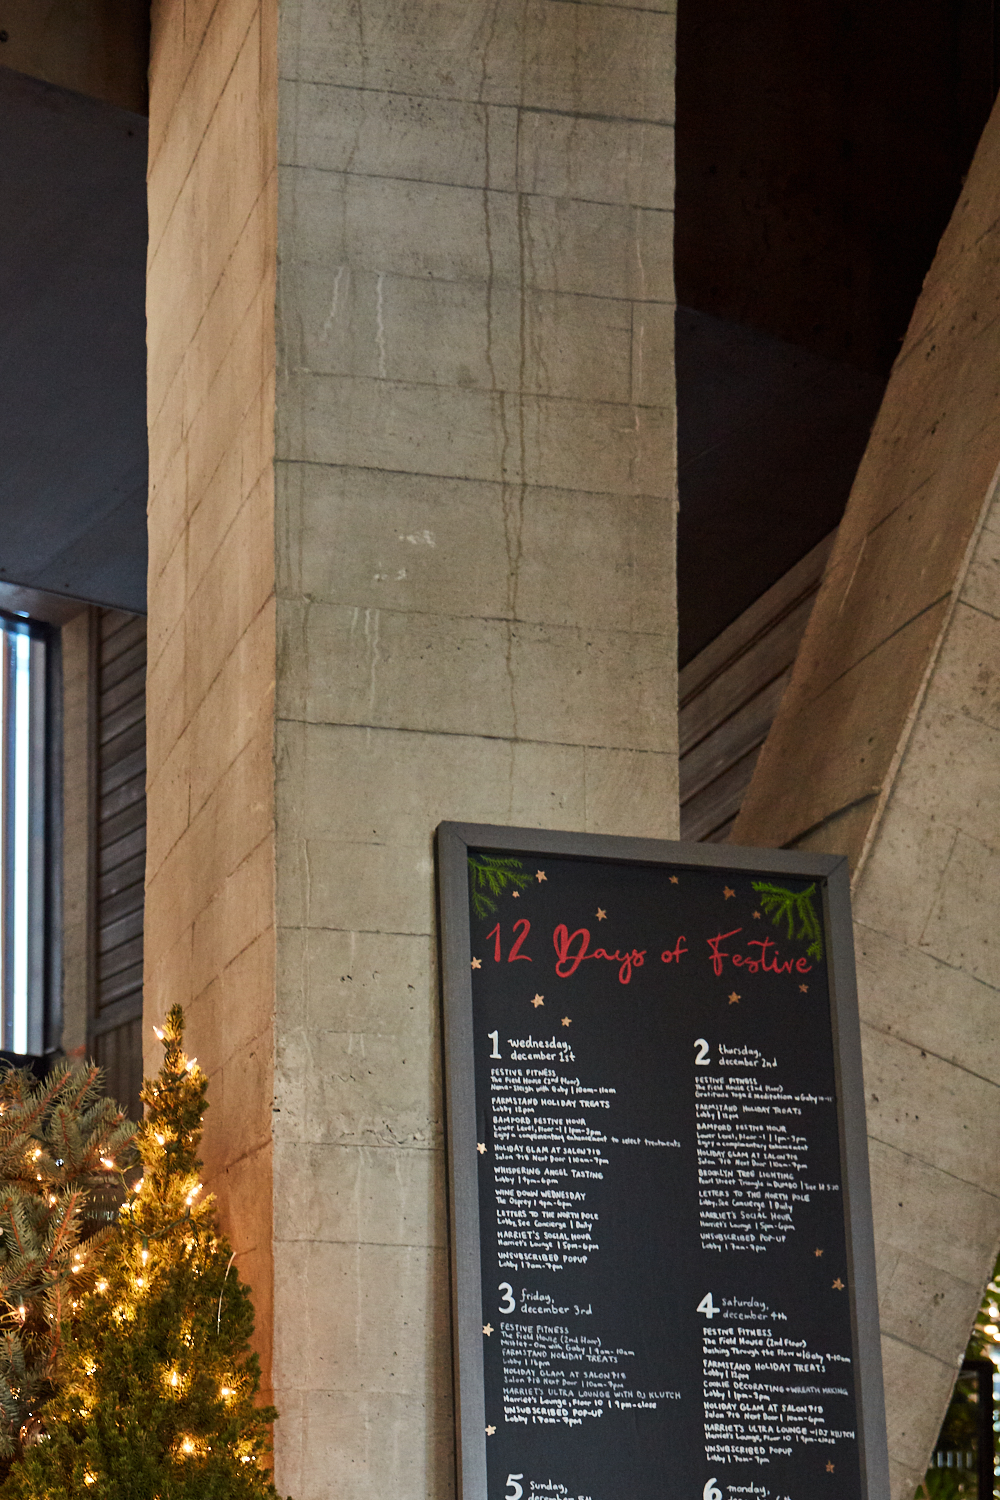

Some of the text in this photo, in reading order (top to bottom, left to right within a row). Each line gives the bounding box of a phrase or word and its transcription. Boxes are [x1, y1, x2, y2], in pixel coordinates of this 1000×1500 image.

[486, 918, 812, 985] 12 Days of Festive
[487, 1029, 502, 1060] 1
[507, 1035, 572, 1053] wednesday,
[510, 1050, 576, 1063] december 1st
[693, 1038, 711, 1066] 2
[718, 1057, 778, 1069] december 2nd
[570, 1168, 604, 1180] TASTING
[759, 1171, 794, 1181] LIGHTING
[495, 1189, 586, 1201] WINE DOWN WEDNESDAY
[740, 1211, 767, 1220] SOCIAL
[770, 1213, 793, 1222] HOUR
[700, 1233, 756, 1242] UNSUBSCRIBED
[497, 1251, 559, 1262] UNSUBSCRIBED
[498, 1282, 516, 1315] 3
[520, 1288, 555, 1304] friday,
[520, 1304, 592, 1316] december 3rd
[696, 1292, 721, 1319] 4
[722, 1308, 788, 1321] december 4th
[738, 1337, 764, 1346] House
[703, 1359, 826, 1373] FARMSTAND HOLIDAY TREATS
[547, 1388, 574, 1397] ULTRA
[578, 1389, 611, 1399] LOUNGE
[614, 1390, 633, 1399] WITH
[636, 1391, 646, 1400] DJ
[648, 1391, 682, 1400] KLUTCH
[726, 1481, 771, 1498] monday,
